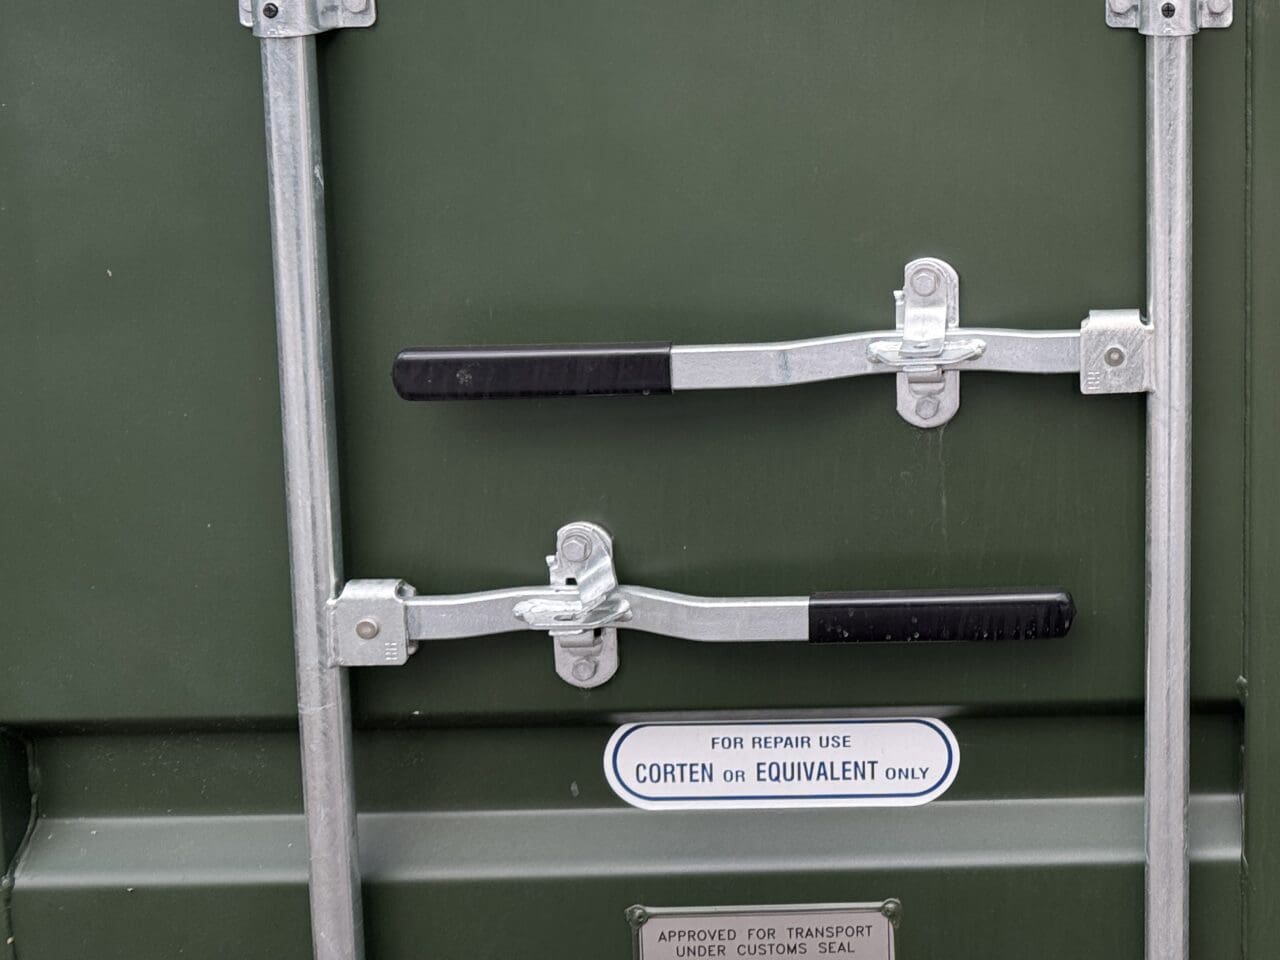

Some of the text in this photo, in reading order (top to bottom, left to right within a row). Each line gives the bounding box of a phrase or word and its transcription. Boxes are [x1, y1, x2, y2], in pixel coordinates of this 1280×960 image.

[711, 735, 852, 750] FOR REPAIR USE
[635, 760, 930, 784] CORTEN OR EQUIVALENT ONLY
[658, 925, 873, 943] APPROVED FOR TRANSPORT
[676, 941, 856, 958] UNDER CUSTOMS SEAL
